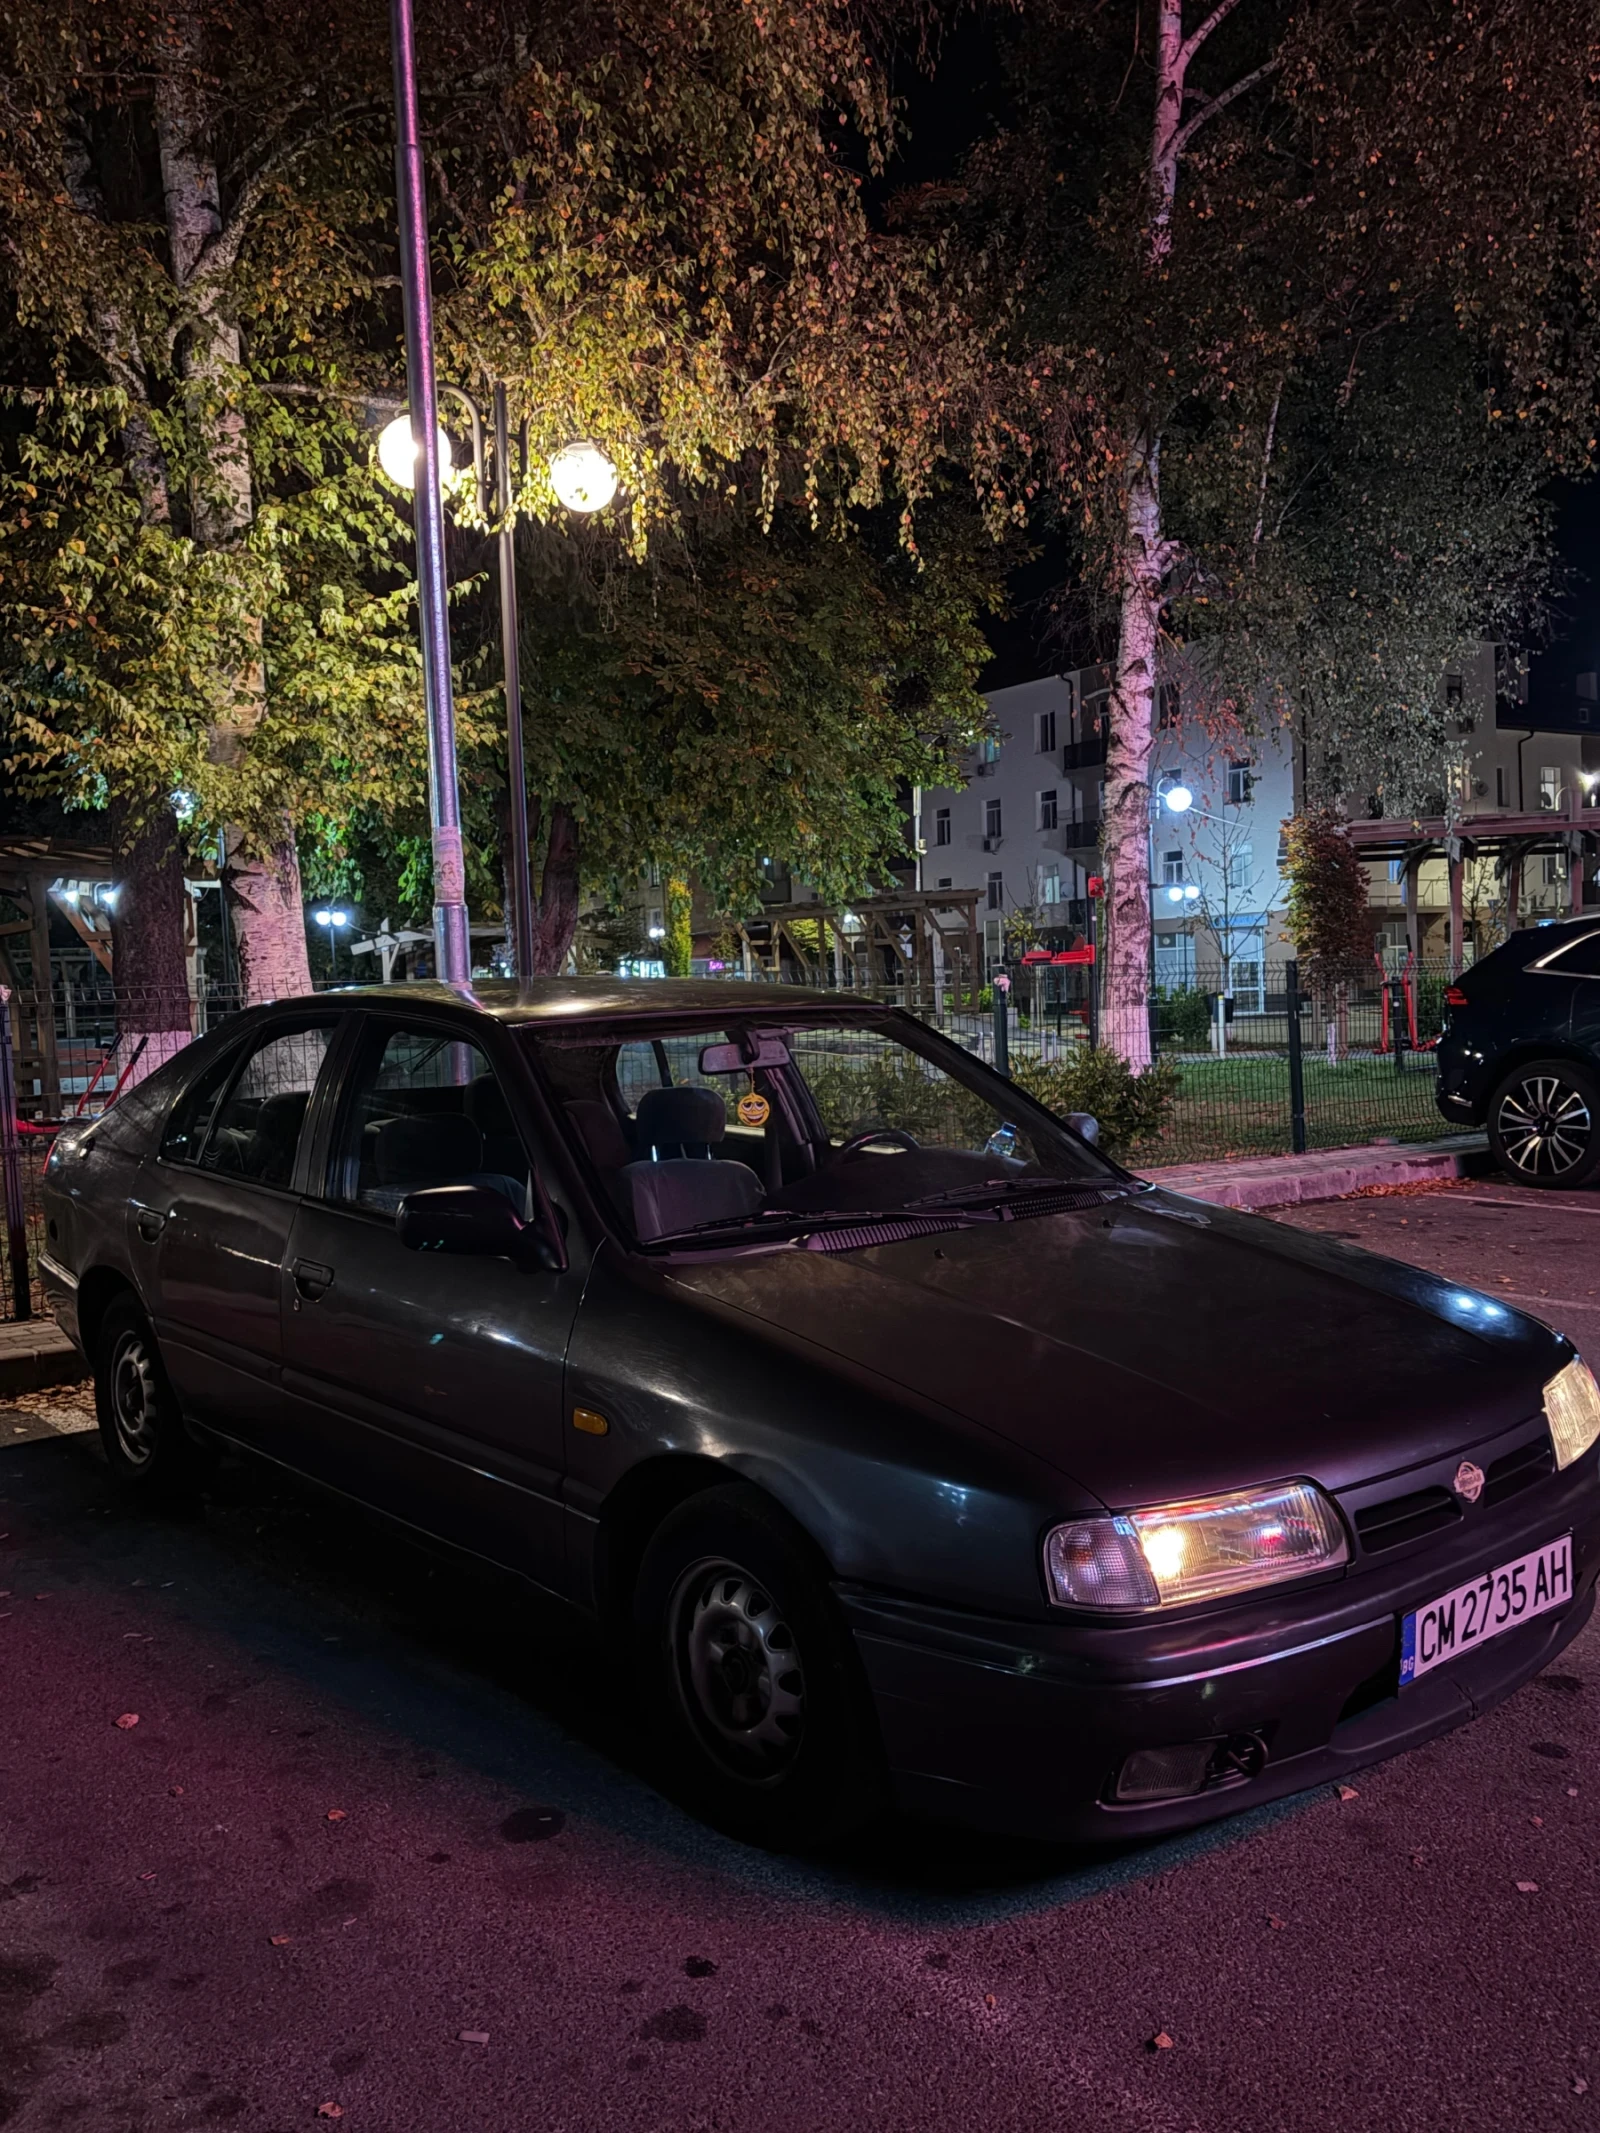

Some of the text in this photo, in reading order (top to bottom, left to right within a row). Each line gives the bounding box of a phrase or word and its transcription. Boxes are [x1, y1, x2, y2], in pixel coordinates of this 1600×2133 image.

[1420, 1545, 1568, 1663] CM 2735 AH
[1402, 1655, 1415, 1675] BG
